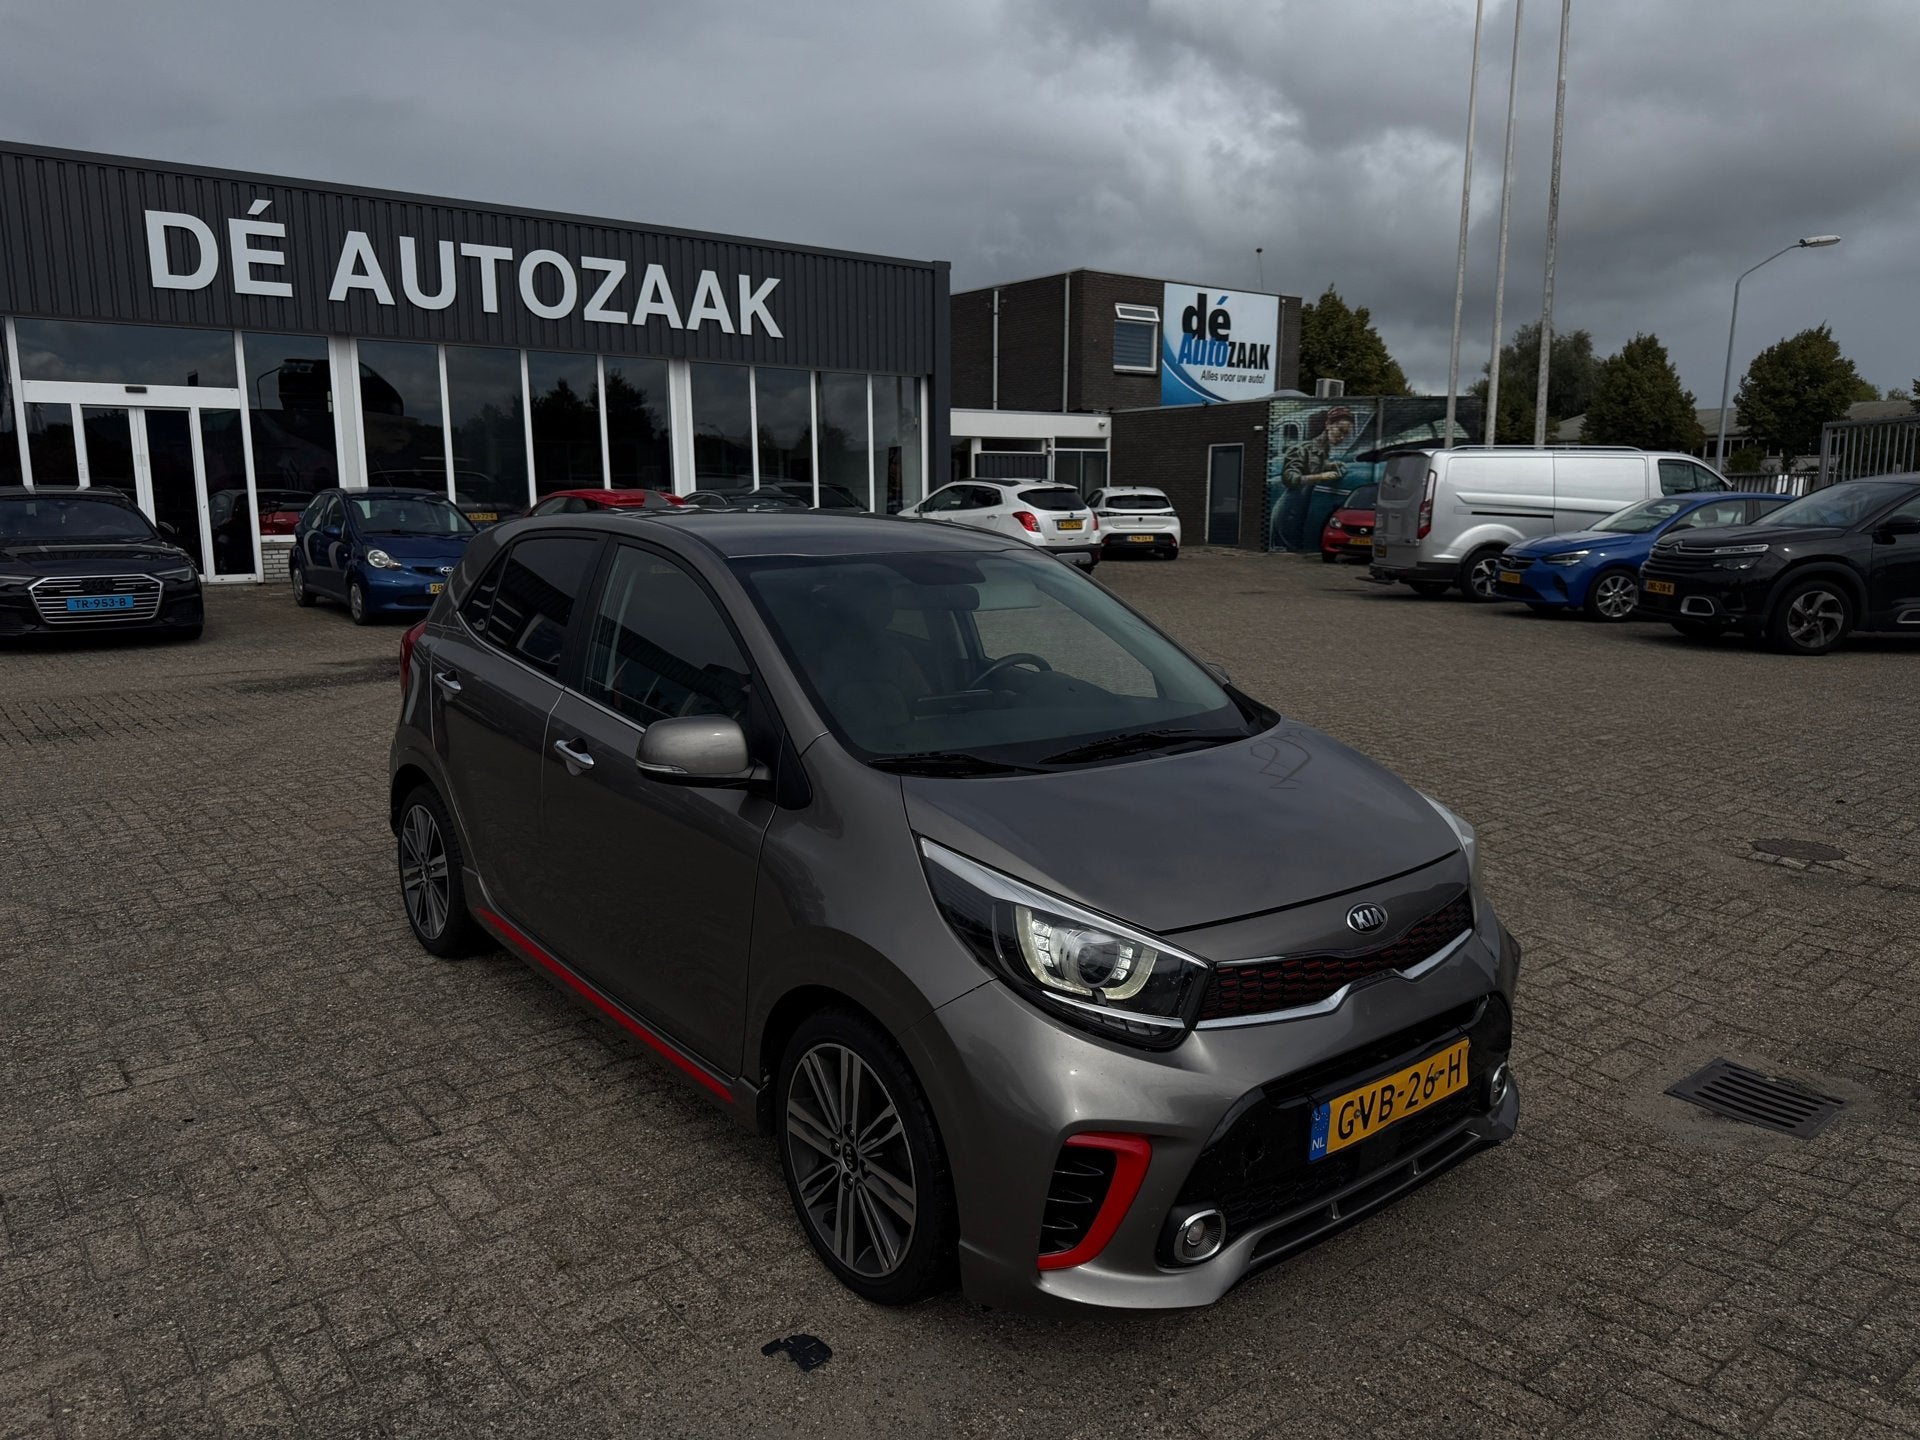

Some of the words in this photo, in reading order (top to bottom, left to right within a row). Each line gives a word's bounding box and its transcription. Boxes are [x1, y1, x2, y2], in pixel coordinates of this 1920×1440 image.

[145, 199, 293, 297] DÉ
[328, 230, 784, 338] AUTOZAAK
[1182, 293, 1231, 342] dé
[1201, 370, 1219, 381] Alles
[1220, 373, 1236, 382] voor
[1237, 374, 1248, 383] uw
[1248, 374, 1266, 384] auto!
[75, 597, 127, 609] TR-953-B
[1352, 907, 1384, 930] KIA
[1337, 1048, 1462, 1140] GVB-26-H
[1311, 1136, 1326, 1151] NL
